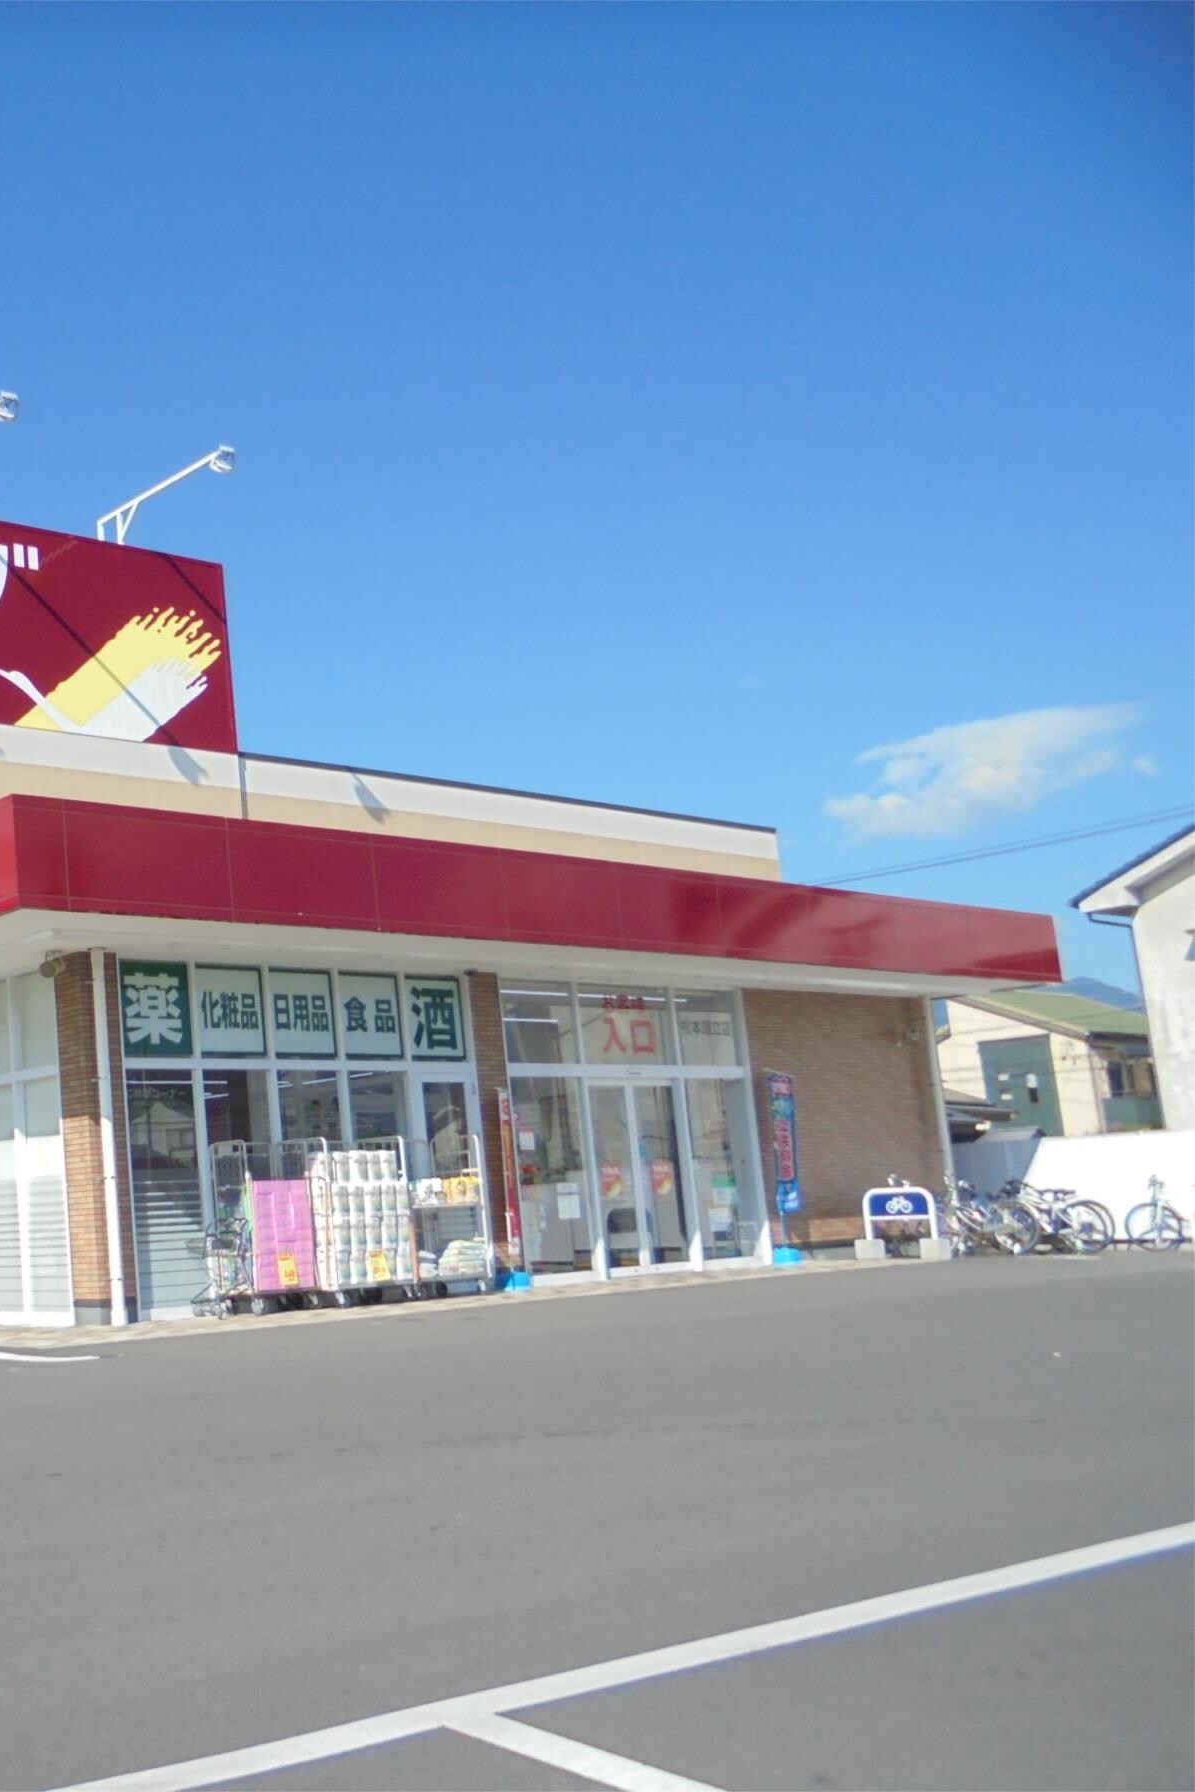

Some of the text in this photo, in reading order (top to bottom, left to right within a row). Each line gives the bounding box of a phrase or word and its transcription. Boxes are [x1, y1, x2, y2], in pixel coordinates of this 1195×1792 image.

[123, 971, 183, 1045] 薬
[201, 990, 260, 1031] 化粧品
[273, 993, 330, 1032] 日用品
[343, 996, 397, 1034] 食品
[410, 986, 458, 1050] 酒
[602, 1017, 657, 1055] 入口
